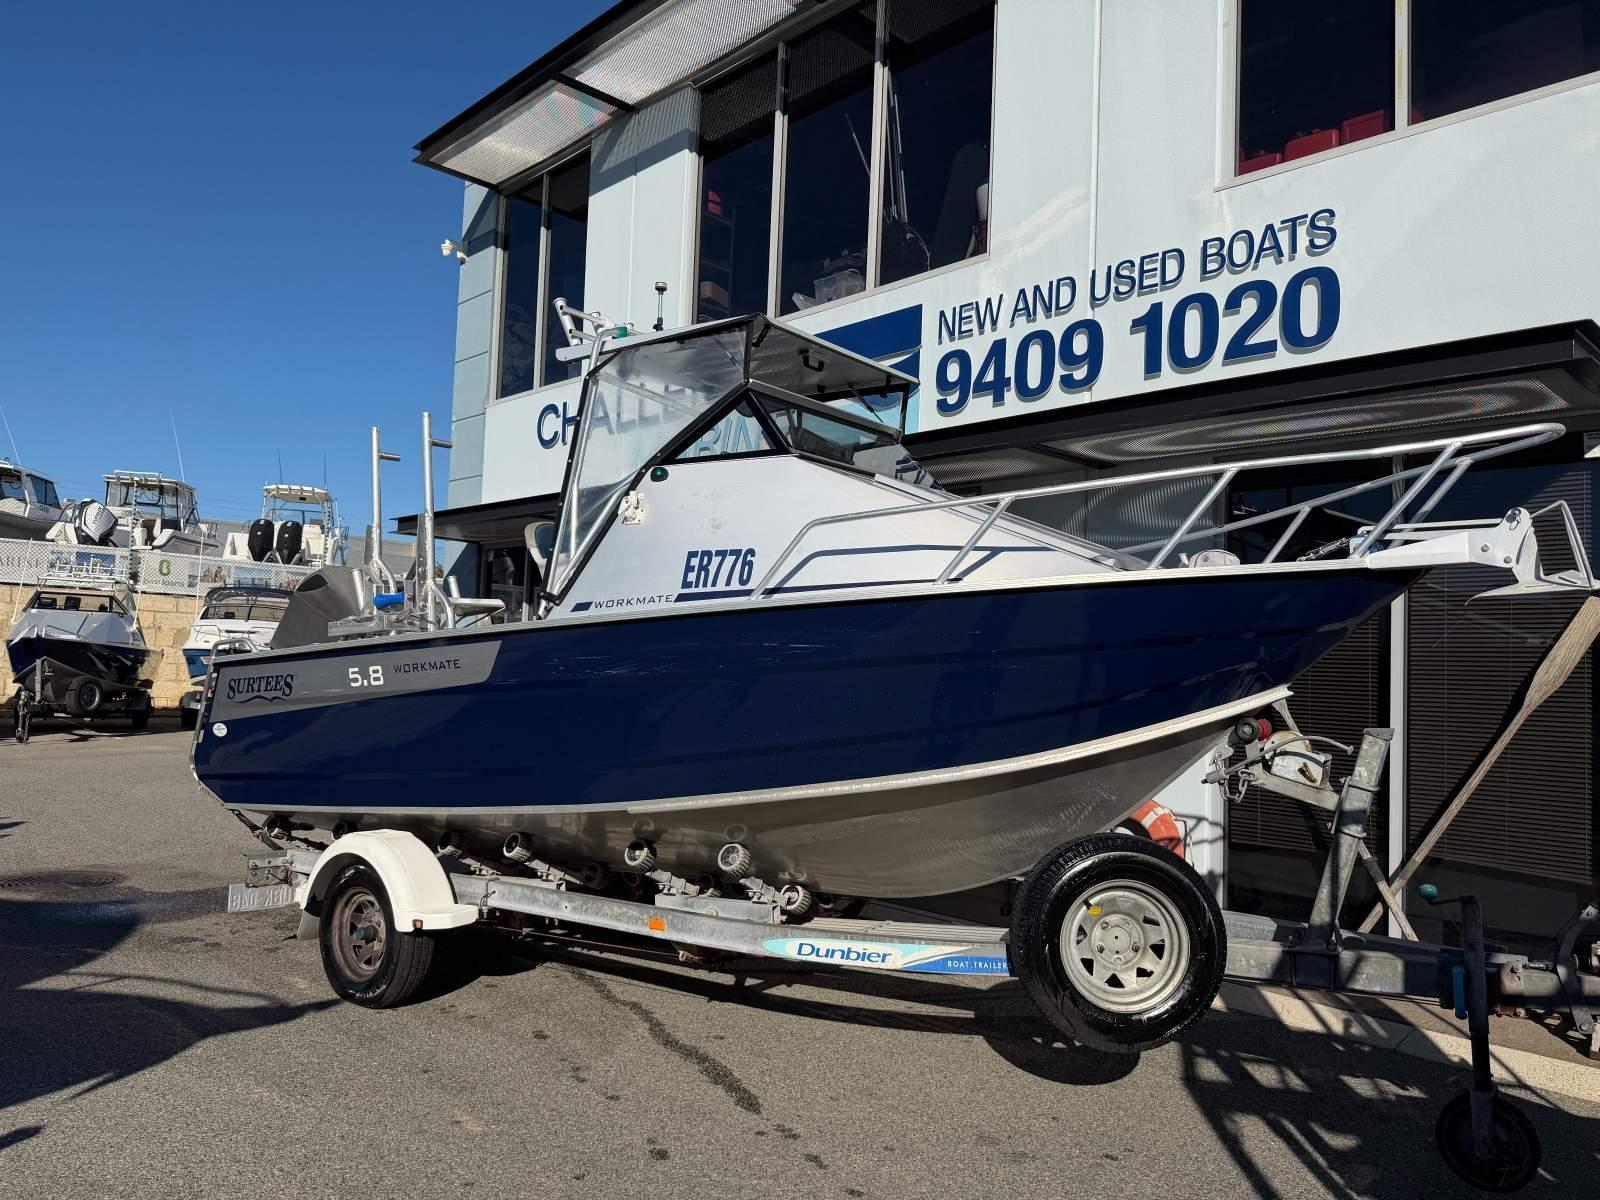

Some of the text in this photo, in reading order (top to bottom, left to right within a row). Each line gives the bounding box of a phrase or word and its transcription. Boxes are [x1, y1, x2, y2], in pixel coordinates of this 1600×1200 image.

[938, 208, 1338, 344] NEW AND USED BOATS
[935, 266, 1341, 417] 9409 1020
[681, 547, 756, 590] ER776
[594, 594, 673, 609] WORKMATE
[348, 665, 385, 687] 5.8
[393, 659, 461, 673] WORKMATE
[227, 673, 294, 700] SURTEES
[797, 942, 892, 963] Dunbier
[947, 960, 969, 968] BOAT
